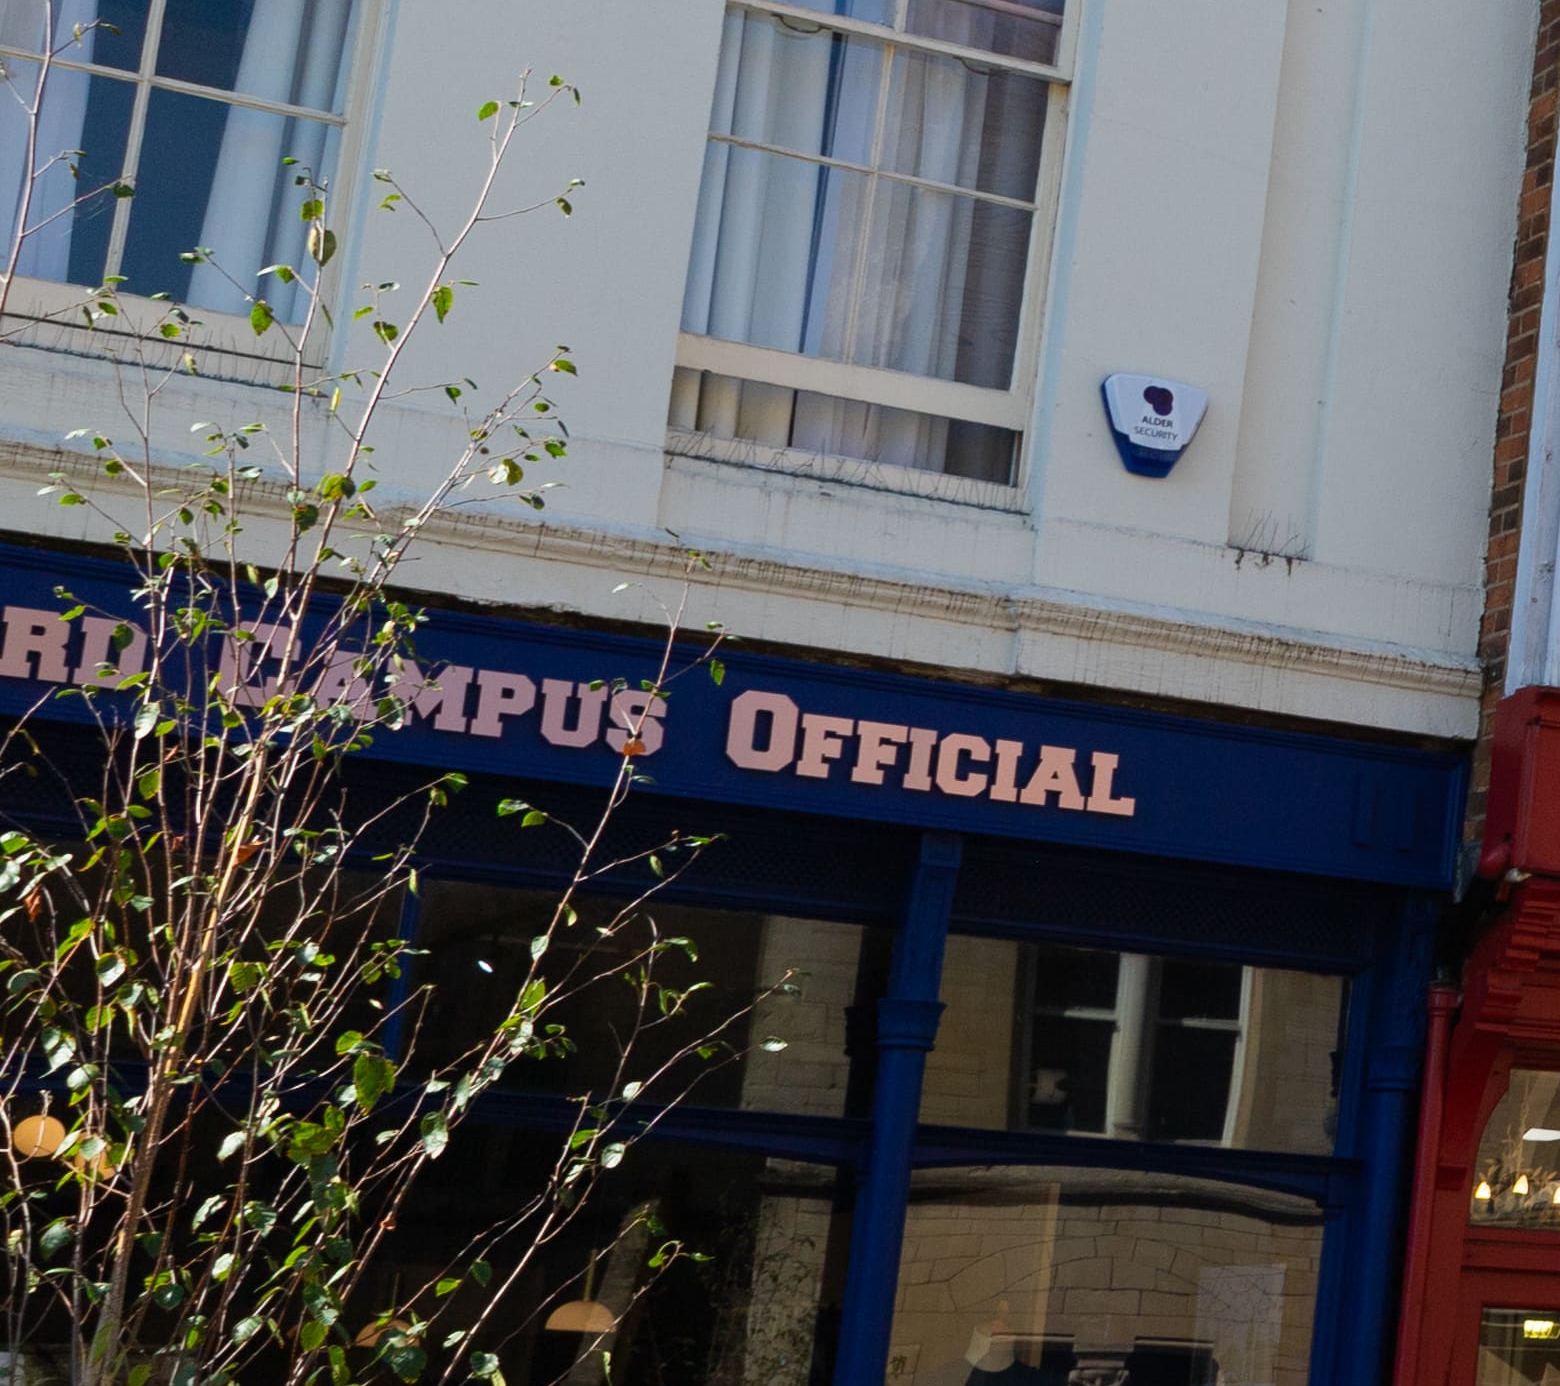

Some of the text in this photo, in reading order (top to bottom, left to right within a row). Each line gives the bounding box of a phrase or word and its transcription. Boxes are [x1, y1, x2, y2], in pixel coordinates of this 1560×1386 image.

[1142, 415, 1173, 428] ALDER
[1134, 426, 1178, 441] SECURITY
[725, 689, 1136, 816] OFFICIAL
